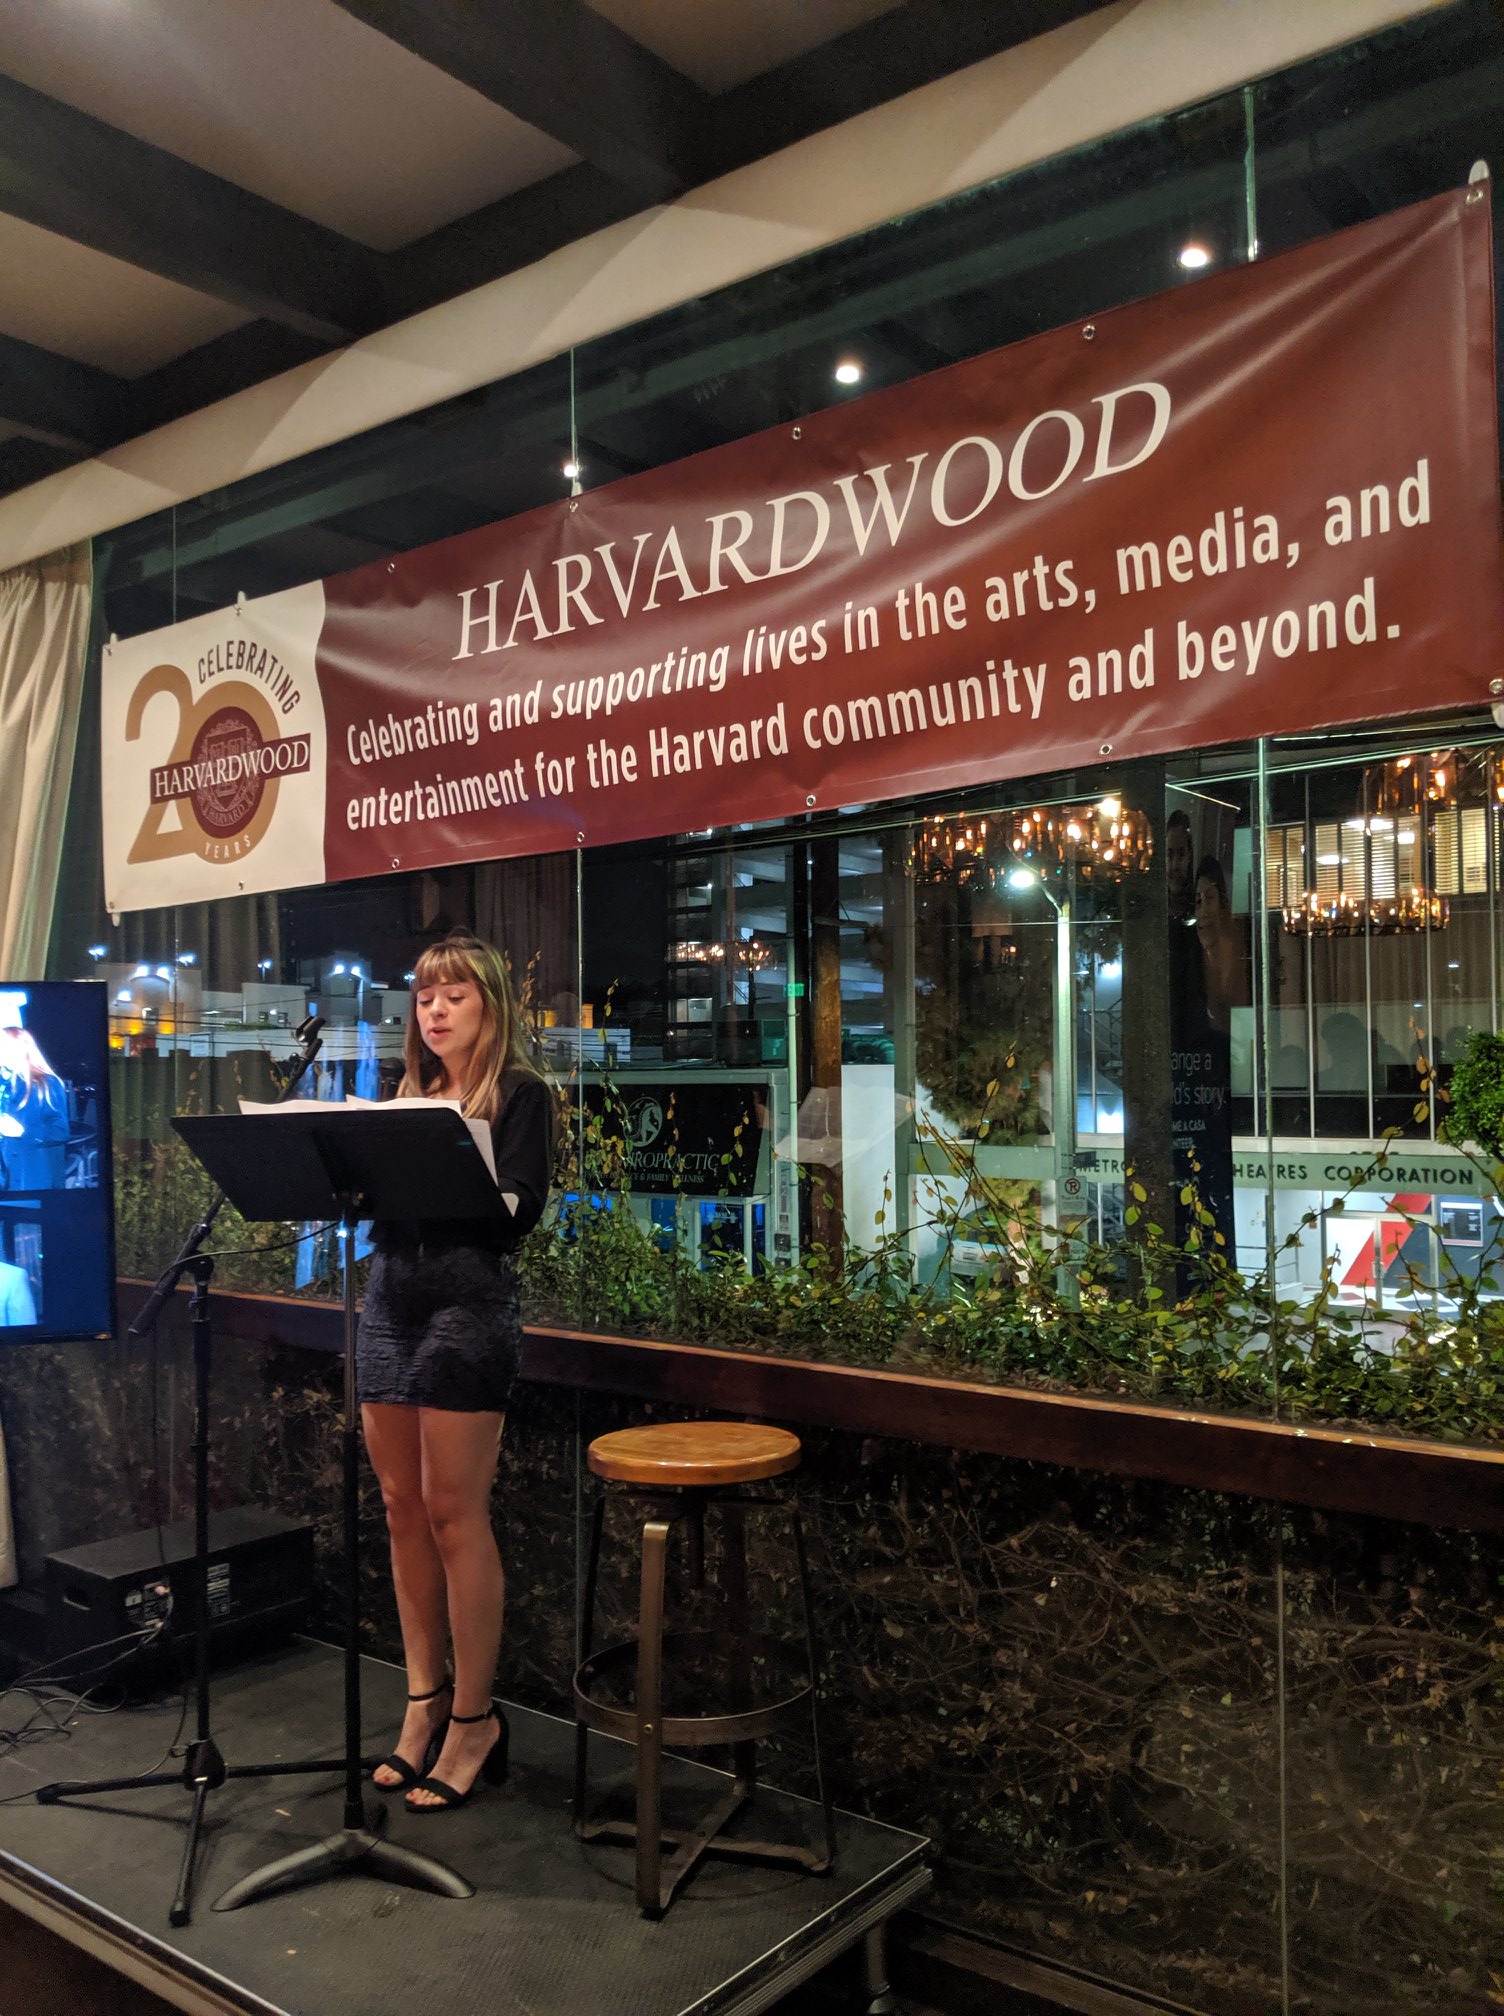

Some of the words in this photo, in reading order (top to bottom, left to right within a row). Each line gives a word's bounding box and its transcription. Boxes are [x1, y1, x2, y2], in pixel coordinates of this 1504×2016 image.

[452, 382, 1171, 660] HARVARDWOOD
[347, 700, 480, 765] Celebrating
[488, 680, 543, 733] and
[550, 645, 730, 720] supporting
[742, 619, 828, 676] lives
[844, 601, 880, 653] in
[895, 582, 967, 642] the
[984, 555, 1096, 623] arts,
[1116, 506, 1300, 596] media,
[1324, 458, 1431, 547] and
[198, 640, 300, 715] CELEBRATING
[346, 758, 529, 831] entertainment
[534, 751, 576, 798] for
[586, 739, 638, 789] the
[649, 702, 789, 777] Harvard
[803, 658, 1047, 749] community
[1067, 628, 1155, 701] and
[1177, 577, 1401, 681] beyond.
[125, 664, 282, 865] 20
[155, 741, 309, 798] HARVARDWOOD
[205, 835, 251, 858] YEARS
[1204, 1053, 1212, 1071] a
[672, 1174, 704, 1183] ELLNESS
[1233, 1163, 1308, 1180] HEARES
